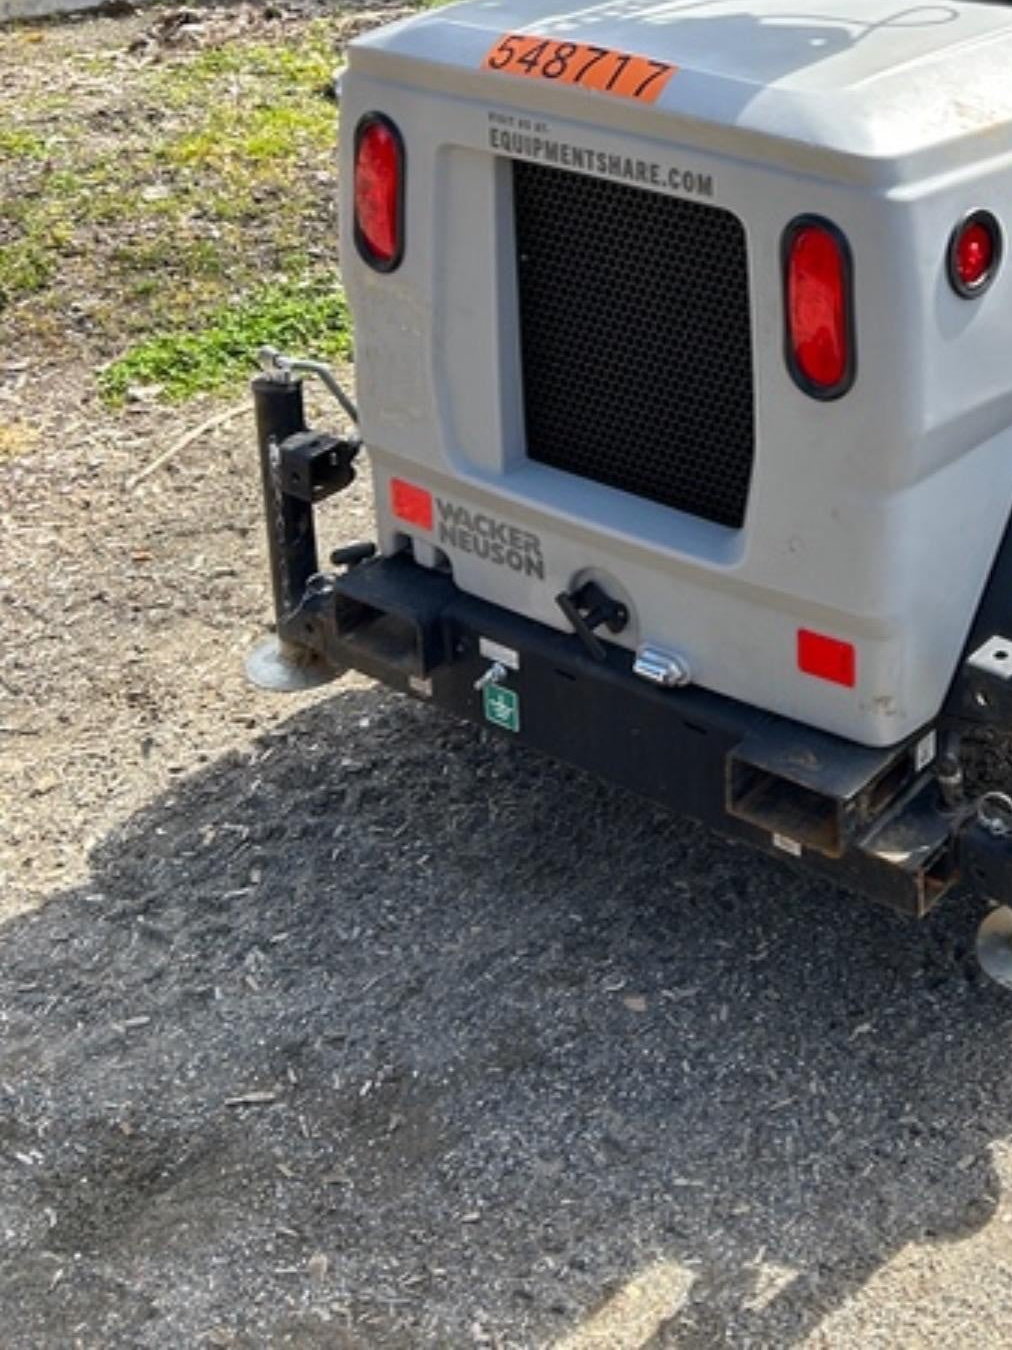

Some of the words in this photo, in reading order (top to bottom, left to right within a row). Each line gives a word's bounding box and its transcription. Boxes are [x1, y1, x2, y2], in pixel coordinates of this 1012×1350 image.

[489, 35, 670, 97] 548717
[488, 128, 713, 196] EQUIPMENTSHARE.COM
[435, 498, 543, 558] WACKER
[438, 522, 545, 580] NEUSON
